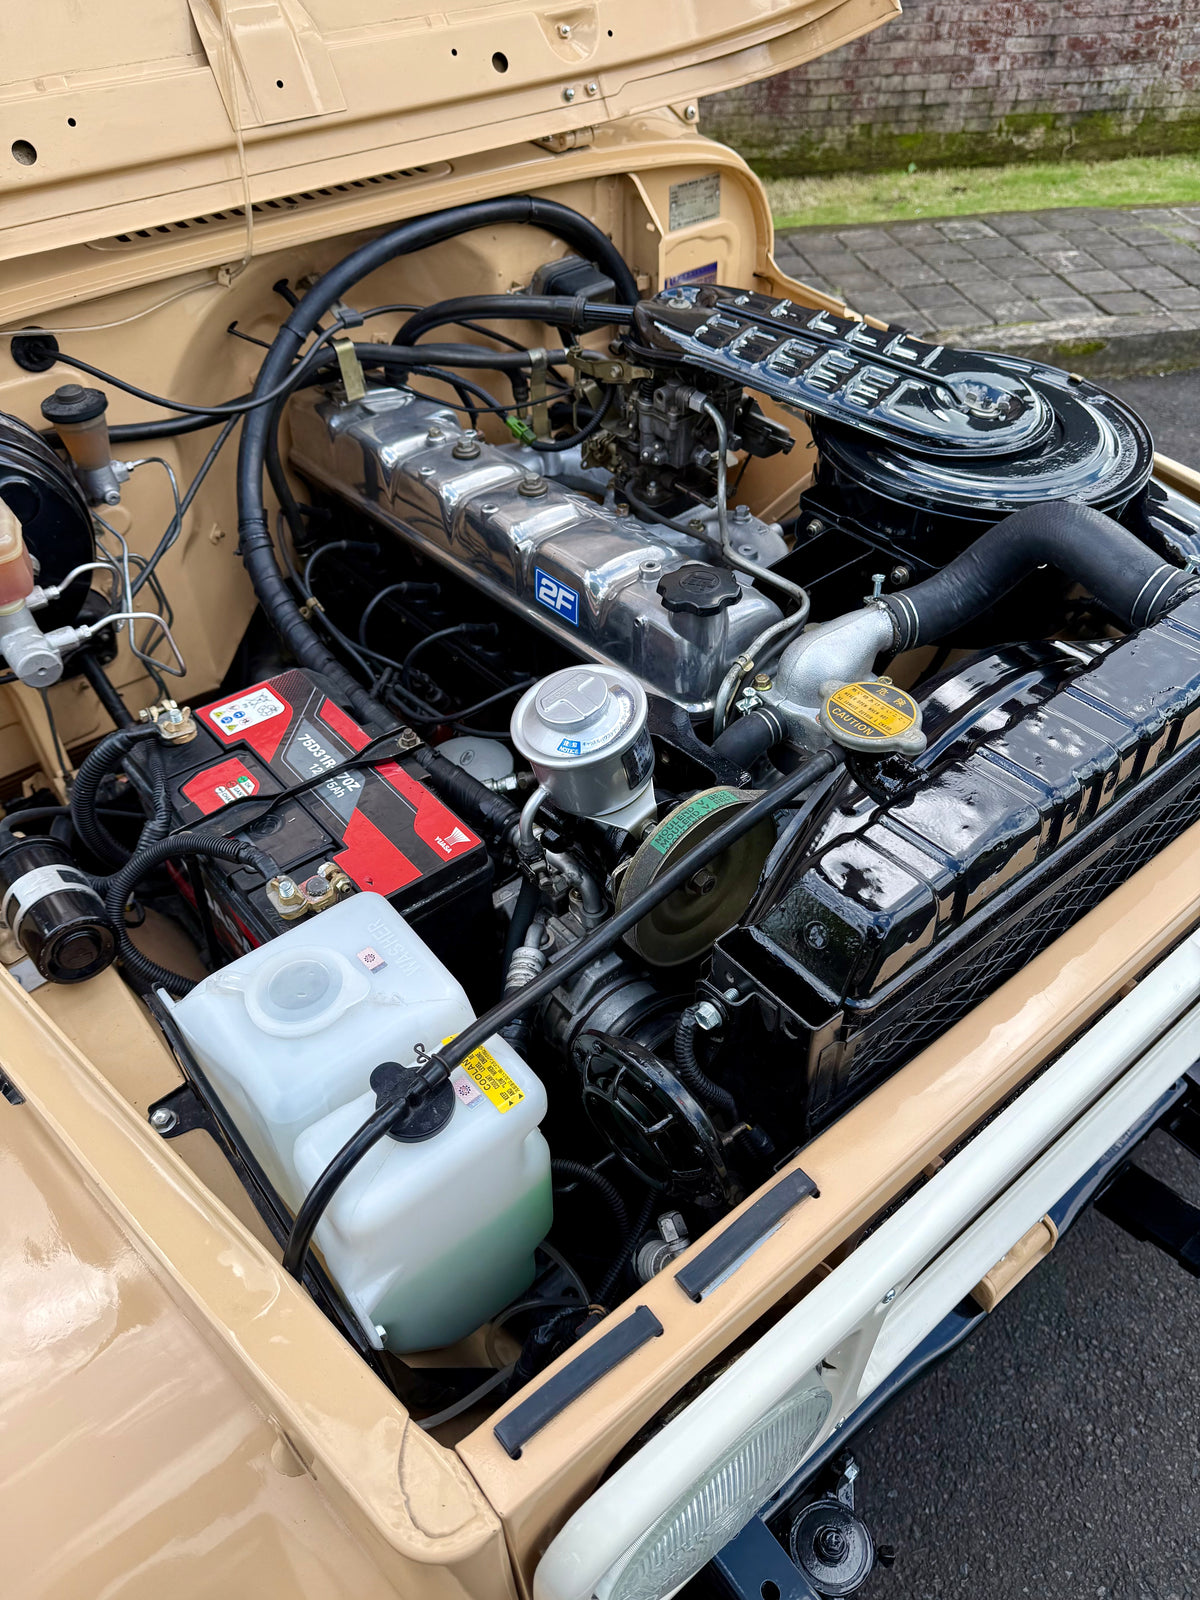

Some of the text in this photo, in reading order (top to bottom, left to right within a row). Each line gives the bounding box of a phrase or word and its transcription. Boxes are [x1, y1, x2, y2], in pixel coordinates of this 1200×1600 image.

[539, 577, 575, 610] 2F
[832, 708, 874, 736] CAUTION
[558, 746, 579, 755] NOTICE
[435, 836, 452, 853] YUASA
[368, 918, 421, 977] WASHER
[462, 1058, 491, 1091] COOLAN
